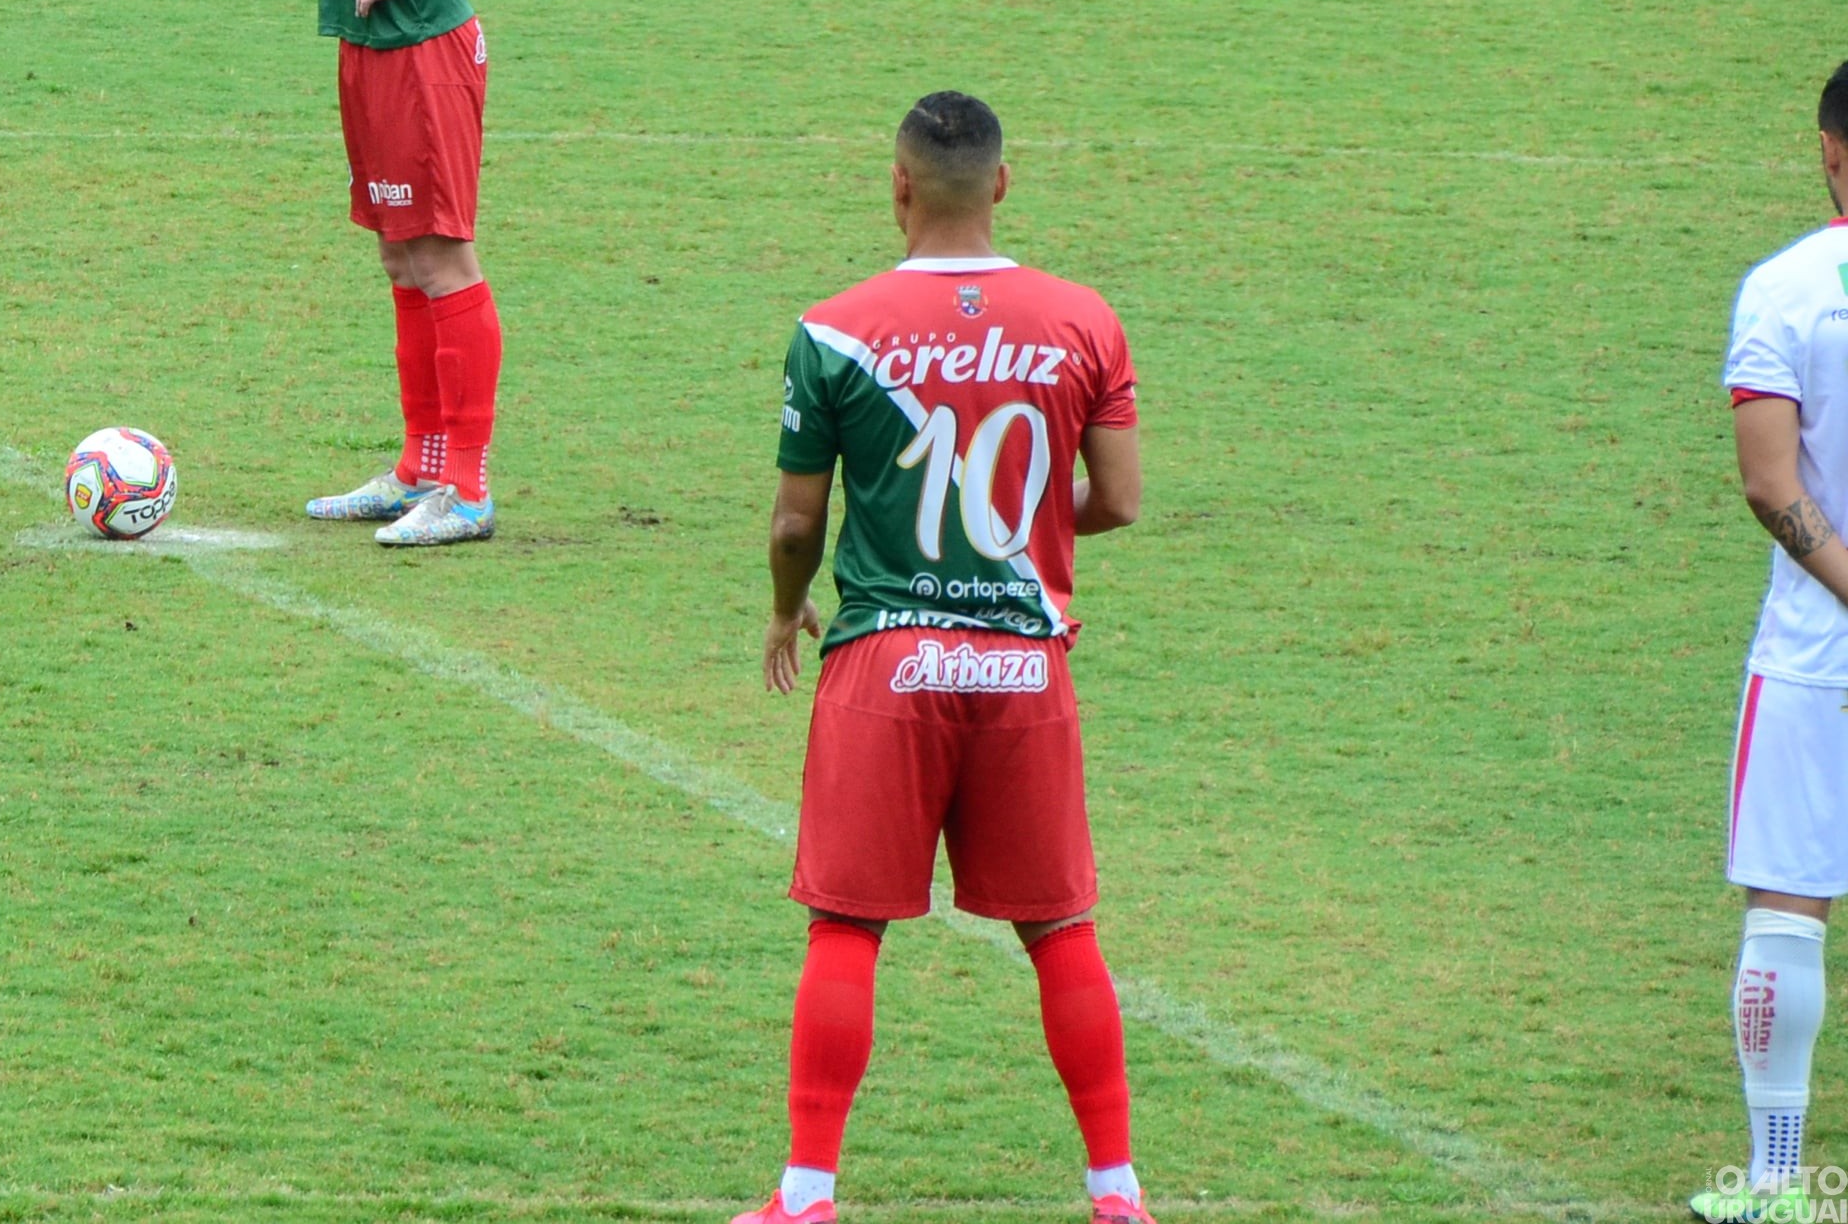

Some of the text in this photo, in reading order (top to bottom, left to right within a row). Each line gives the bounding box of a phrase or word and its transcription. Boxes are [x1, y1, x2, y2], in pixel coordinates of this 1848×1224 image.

[873, 332, 956, 350] GRUPO
[876, 327, 1066, 389] creluz
[896, 402, 1051, 562] 10
[891, 640, 1048, 693] Arbaza
